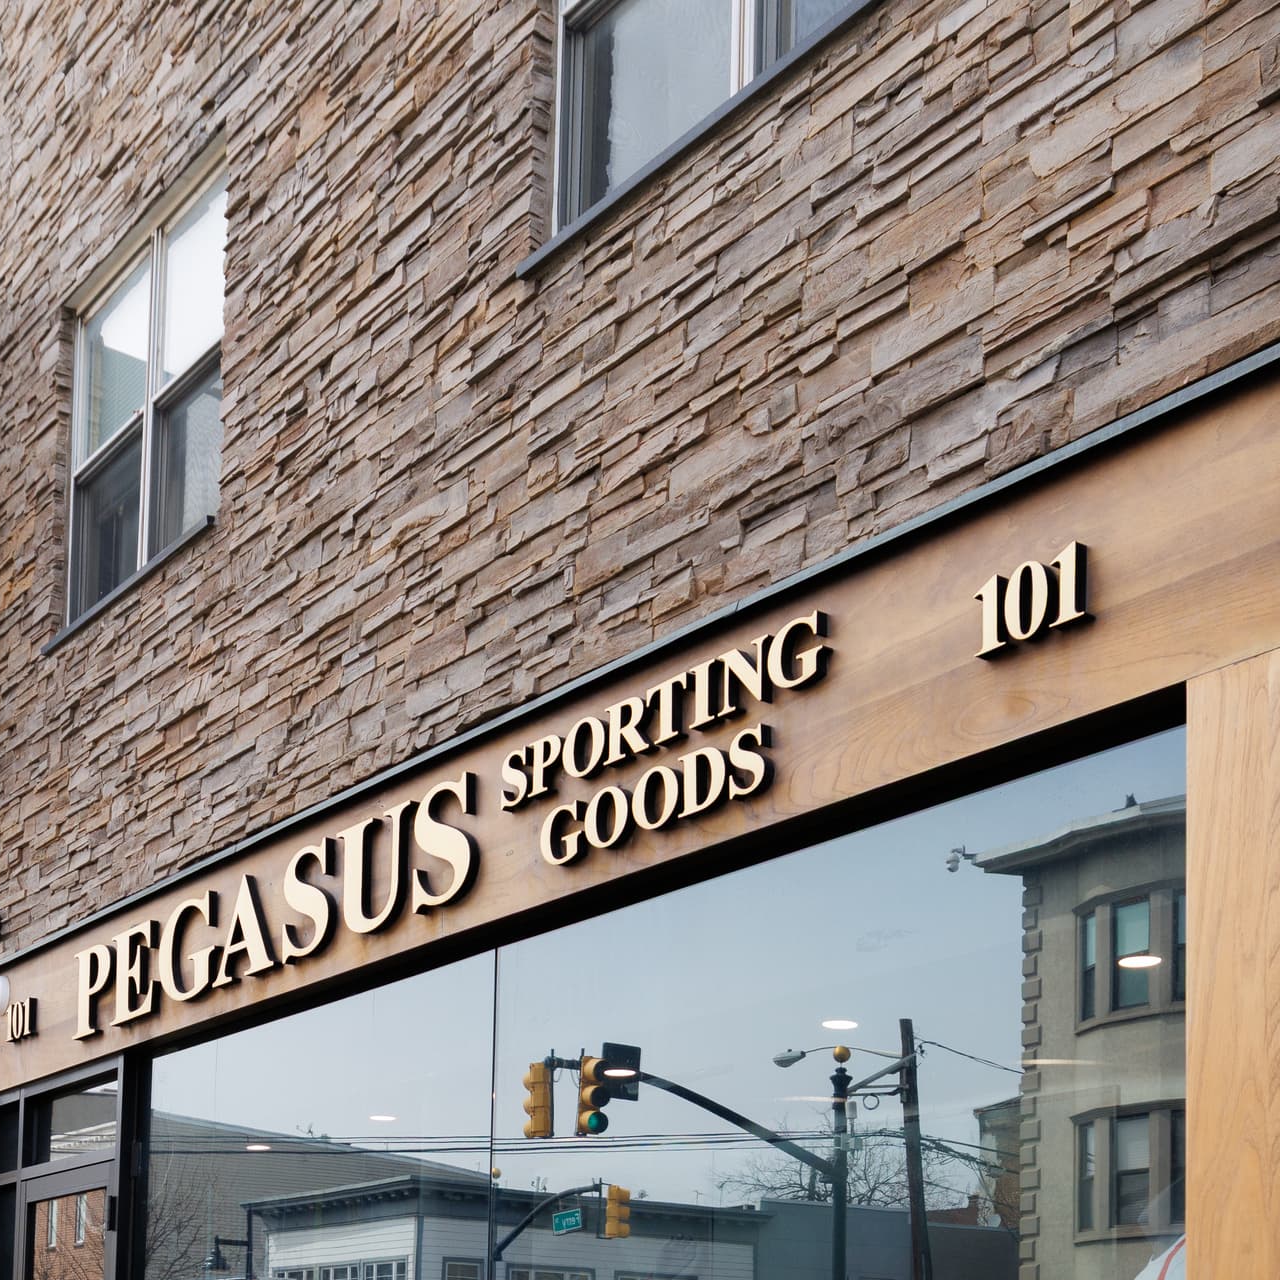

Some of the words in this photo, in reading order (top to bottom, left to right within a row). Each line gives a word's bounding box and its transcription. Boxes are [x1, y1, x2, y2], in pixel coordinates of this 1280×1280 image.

[972, 540, 1088, 659] 101
[500, 610, 833, 812] SPORTING
[540, 722, 777, 866] GOODS
[72, 771, 478, 1041] PEGASUS
[5, 997, 38, 1042] 101
